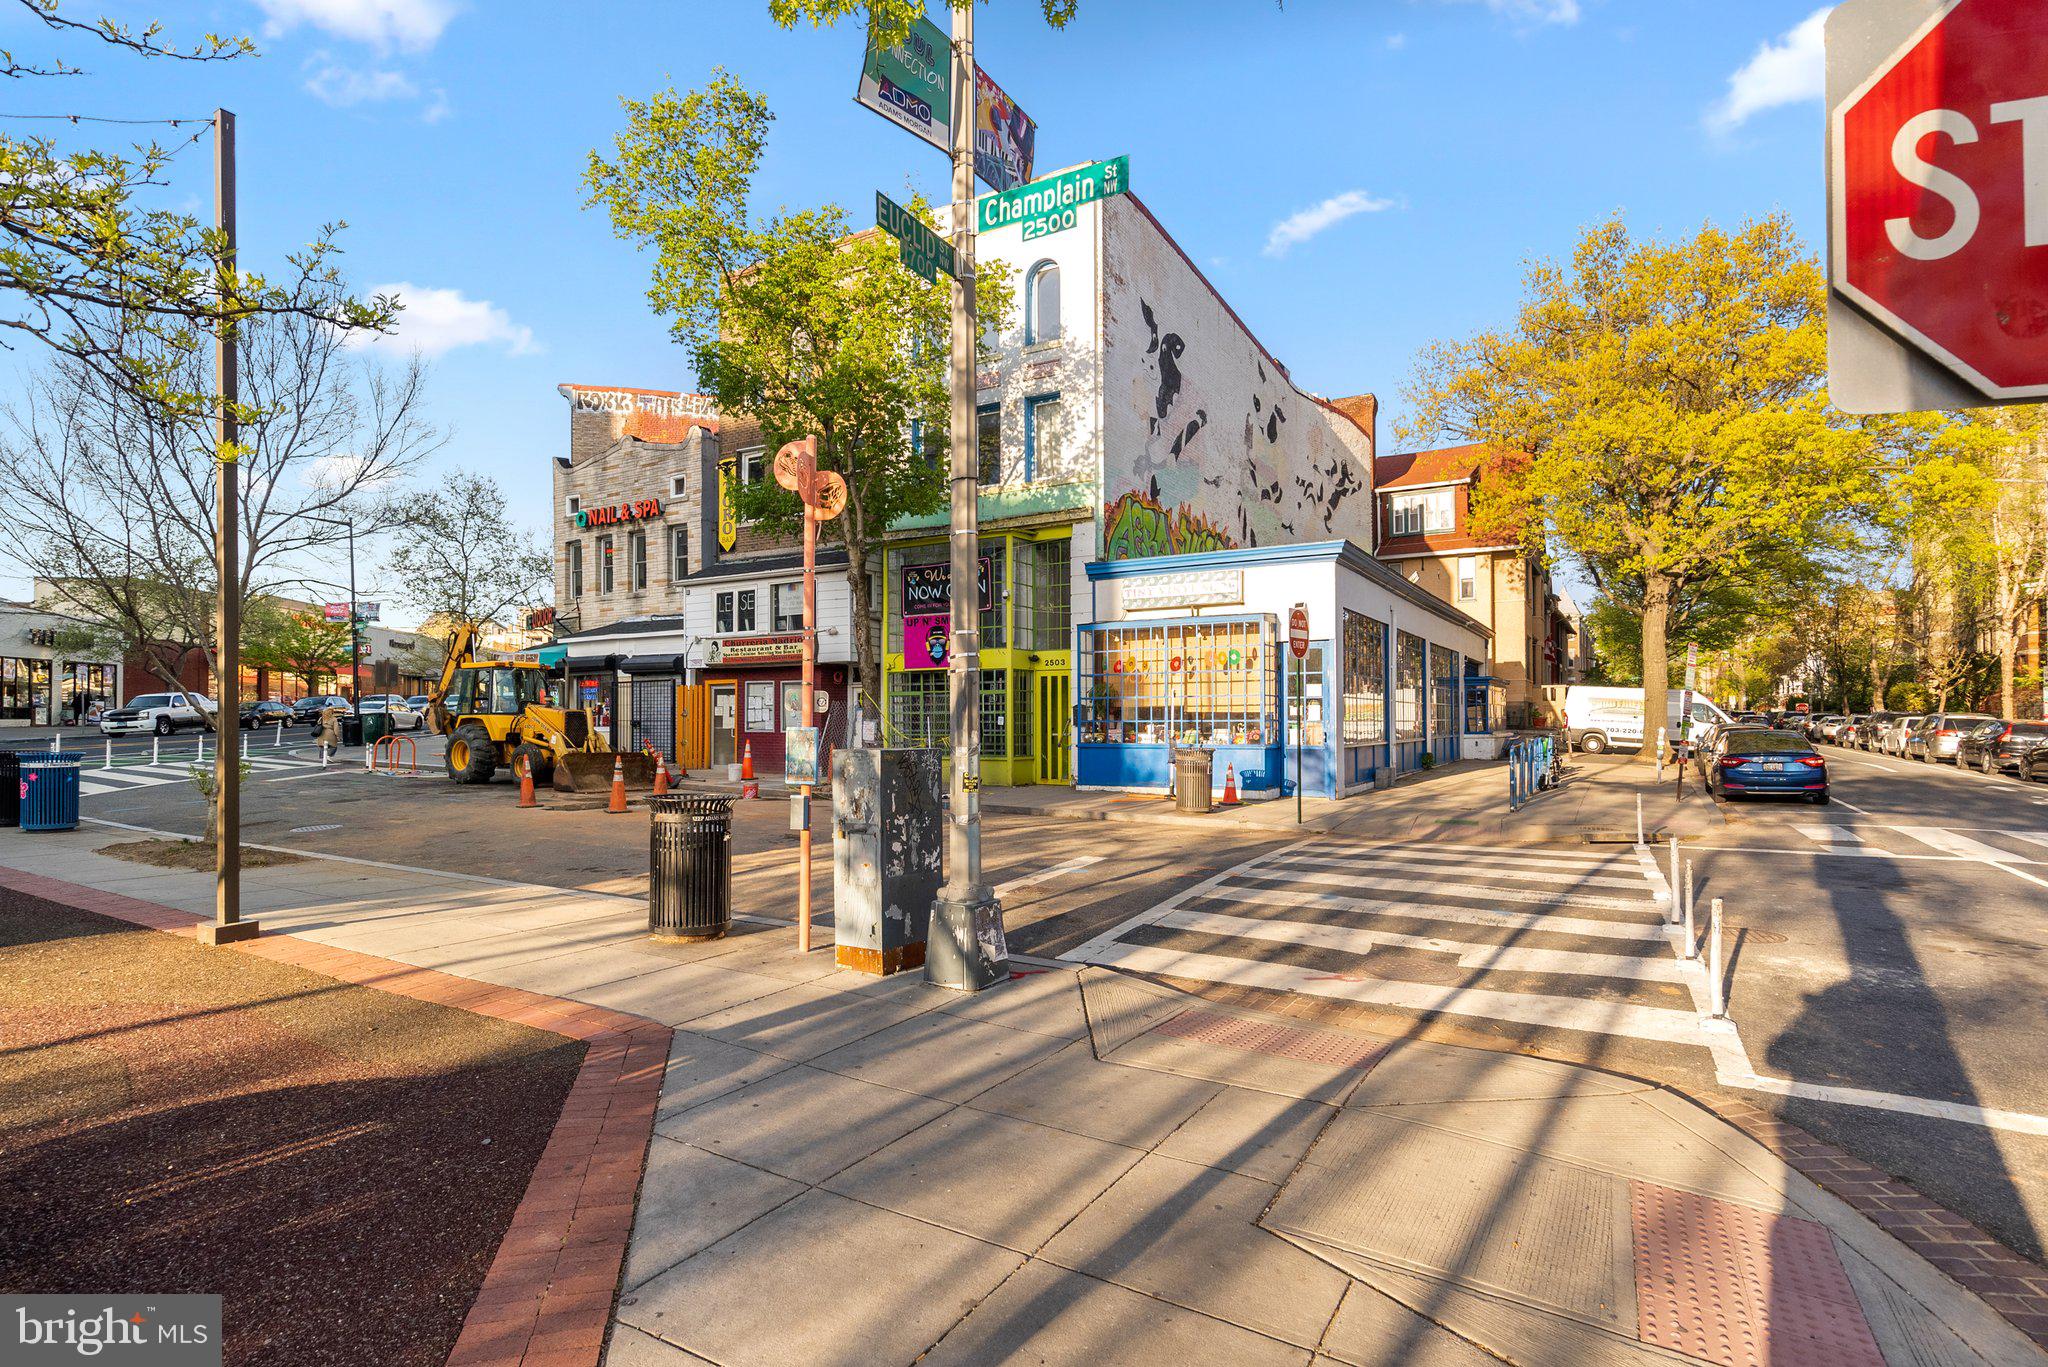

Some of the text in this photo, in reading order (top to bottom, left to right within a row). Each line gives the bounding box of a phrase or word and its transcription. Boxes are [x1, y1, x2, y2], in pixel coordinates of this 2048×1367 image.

[891, 45, 945, 92] NNECTION
[880, 81, 931, 121] ADMO
[878, 101, 932, 137] ADAMS MORGAN
[1103, 179, 1118, 195] NW
[1884, 95, 2048, 261] ST
[985, 164, 1118, 226] Champlain St
[878, 195, 950, 259] EUCLID ST
[1023, 209, 1075, 240] 2500
[902, 241, 934, 279] 1700
[940, 256, 950, 269] NW
[575, 498, 659, 528] Q NAIL & SPA
[722, 481, 733, 535] ORO
[740, 593, 755, 611] SE
[908, 585, 943, 600] NOW
[531, 607, 553, 629] LIQUOR
[906, 618, 919, 627] UP
[935, 616, 949, 625] SM
[1291, 618, 1307, 628] DO NOT
[1292, 640, 1306, 650] ENTER
[1045, 658, 1066, 667] 2503
